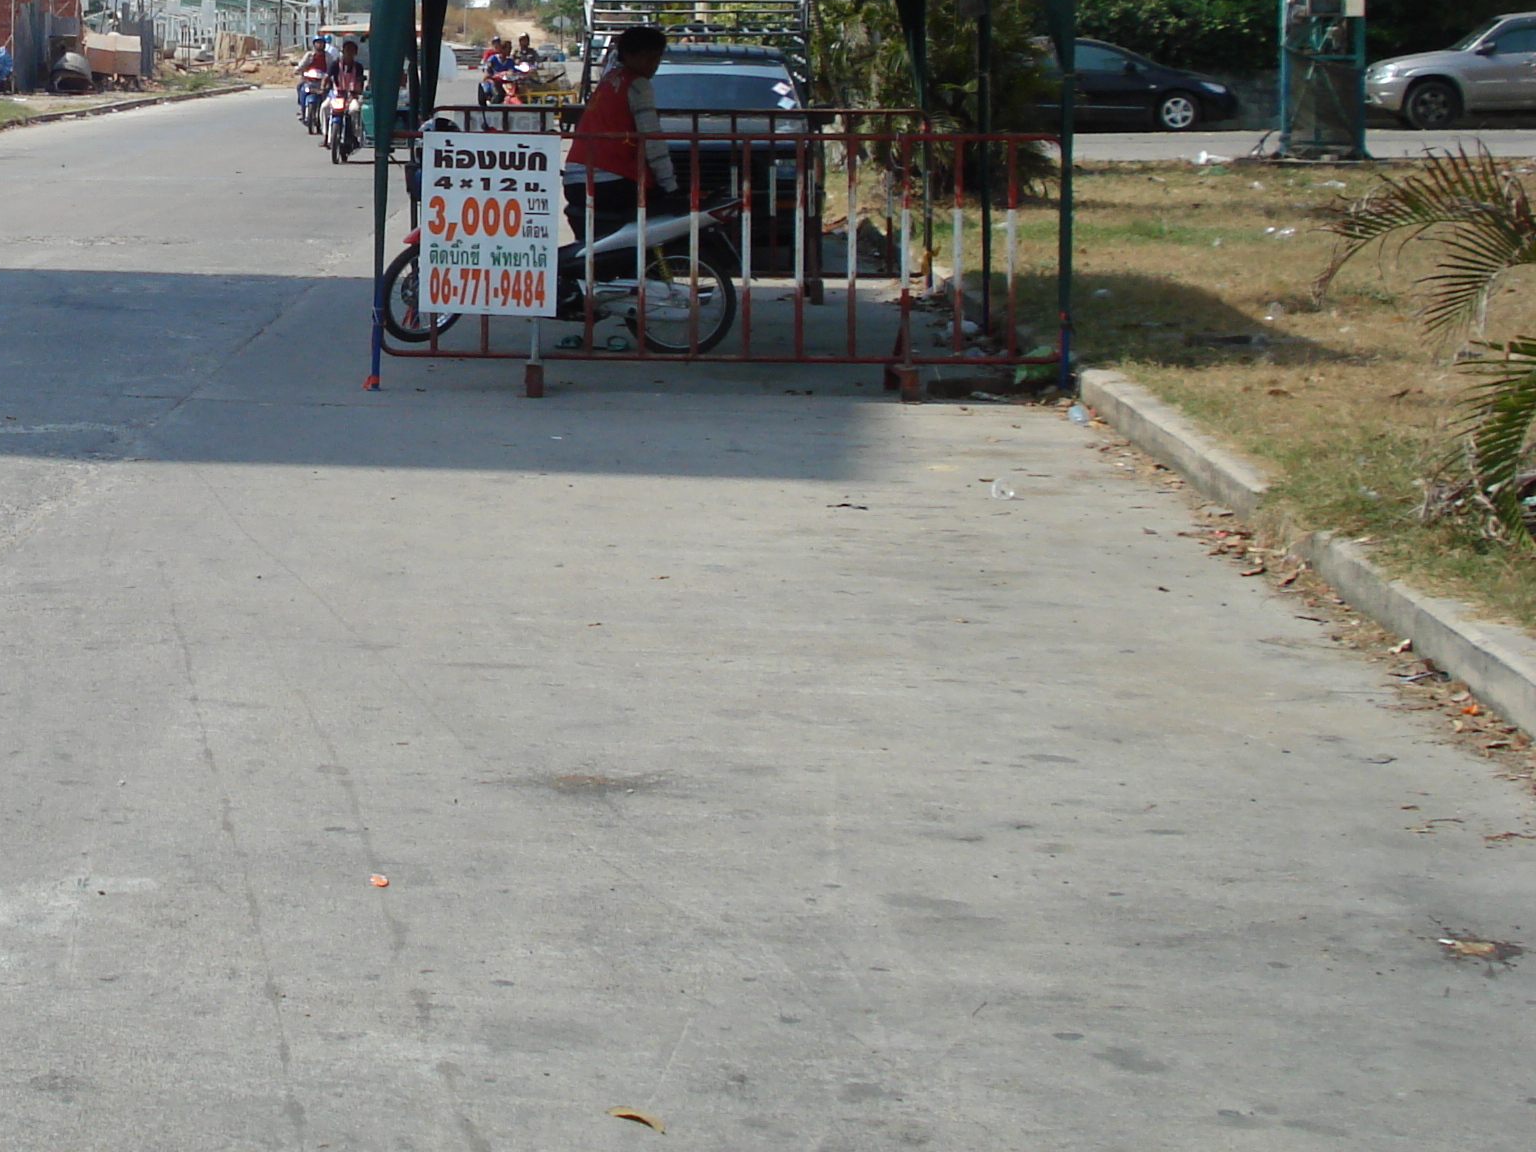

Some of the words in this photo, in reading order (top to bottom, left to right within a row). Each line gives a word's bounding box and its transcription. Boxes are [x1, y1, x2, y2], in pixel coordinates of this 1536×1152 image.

[433, 139, 547, 171] ห้องพัก
[428, 196, 522, 241] 3,000
[527, 198, 549, 211] บาท
[522, 219, 549, 239] เดือน
[429, 239, 480, 266] ติดบิ๊กซี
[429, 267, 546, 308] 06-771-9484
